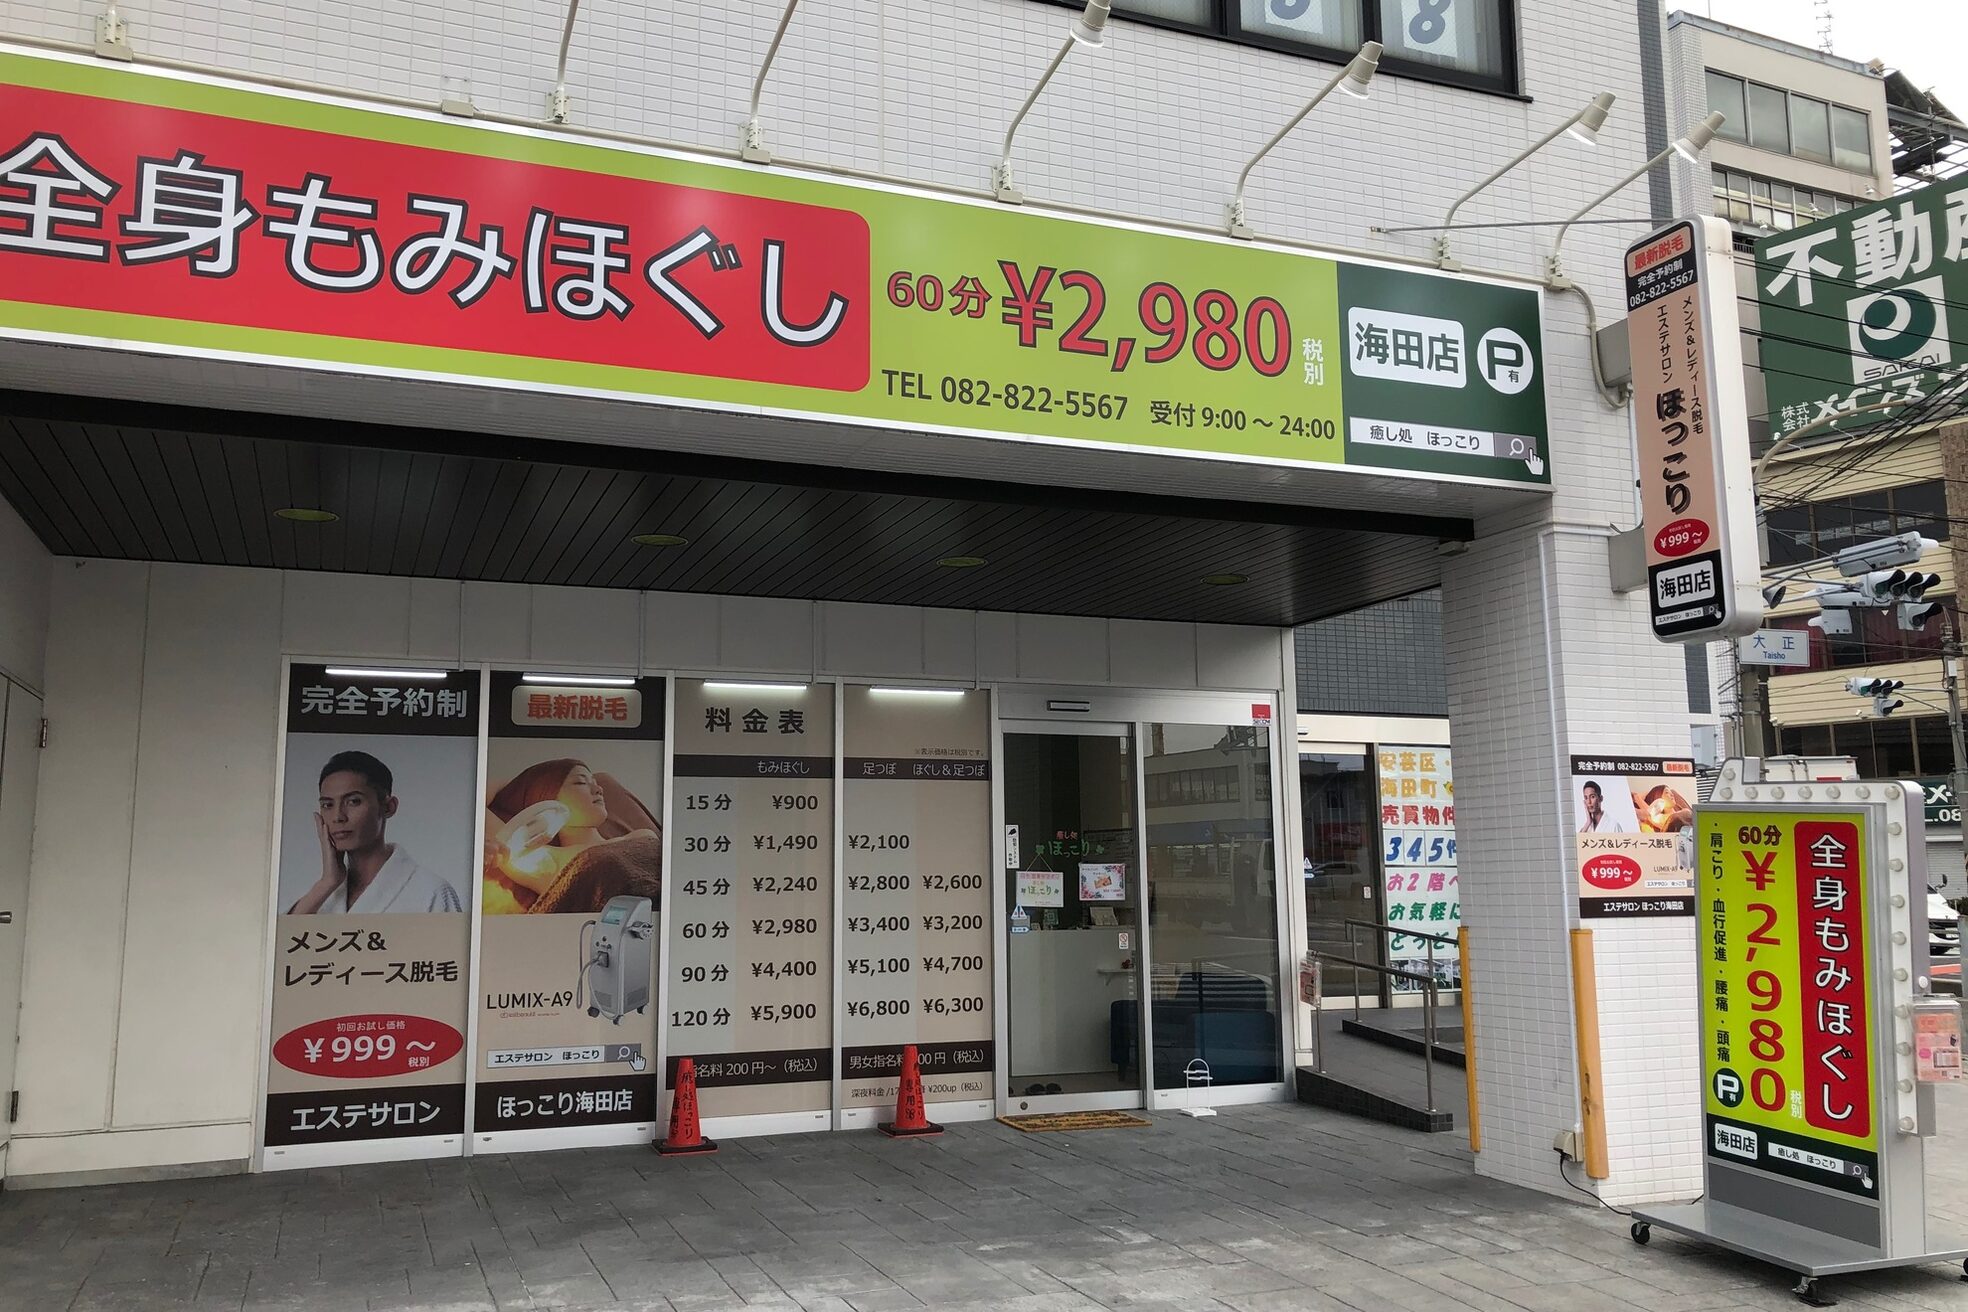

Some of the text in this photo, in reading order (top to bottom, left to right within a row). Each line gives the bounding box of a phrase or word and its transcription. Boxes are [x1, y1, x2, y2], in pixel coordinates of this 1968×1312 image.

[0, 131, 849, 347] 全身もみほぐし
[1634, 234, 1684, 270] 最新脱毛
[1766, 187, 1968, 307] 不動
[1637, 258, 1684, 288] 完全予約制
[1629, 269, 1695, 307] 082-822-5567
[888, 259, 1292, 377] 60分 ¥2,980
[1355, 322, 1460, 374] 海田店
[1656, 304, 1674, 384] エステサロン
[1302, 337, 1325, 387] 税別
[881, 369, 932, 400] TEL
[941, 376, 1128, 420] 082-822-5567
[1150, 400, 1196, 428] 受付
[1369, 424, 1481, 451] 癒し処 ほっこり
[1656, 387, 1691, 515] ほっこり
[1660, 569, 1712, 600] 海田店
[1753, 634, 1796, 650] 大正
[1763, 650, 1786, 660] Taisho
[301, 685, 468, 719] 完全予約制
[528, 693, 629, 722] 最新脱毛
[705, 706, 805, 735] 料金表
[757, 760, 810, 775] もみほぐし
[862, 761, 897, 776] 足つぼ
[1617, 762, 1660, 772] 082-822-5567
[772, 795, 818, 811] ¥900
[753, 835, 818, 853] ¥1,490
[848, 834, 910, 852] ¥2,100
[1048, 840, 1090, 858] ほっこり
[1738, 825, 1782, 846] 60分
[752, 876, 818, 895] ¥2,240
[848, 875, 910, 893] ¥2,800
[922, 875, 982, 892] ¥2,600
[1603, 902, 1640, 912] エステサロン
[752, 918, 817, 937] ¥2,980
[848, 916, 910, 935] ¥3,400
[923, 915, 983, 933] ¥3,200
[285, 960, 459, 987] レディース脱毛
[751, 961, 817, 980] ¥4,400
[848, 958, 910, 977] ¥5,100
[923, 956, 983, 974] ¥4,700
[1810, 834, 1854, 1120] 全身もみほぐし
[487, 991, 573, 1010] LUMIX-A9
[751, 1003, 817, 1023] ¥5,900
[847, 999, 910, 1019] ¥6,800
[923, 997, 984, 1016] ¥6,300
[336, 1020, 406, 1033] 初回お試し価格
[408, 1056, 431, 1068] 税別
[494, 1049, 600, 1064] エステサロン ほっこり
[290, 1101, 441, 1131] エステサロン
[497, 1089, 634, 1119] ほっこり海田店
[1790, 1090, 1803, 1119] 税別
[1717, 1129, 1756, 1155] 海田店
[1777, 1147, 1837, 1170] 癒し処 ほっこり
